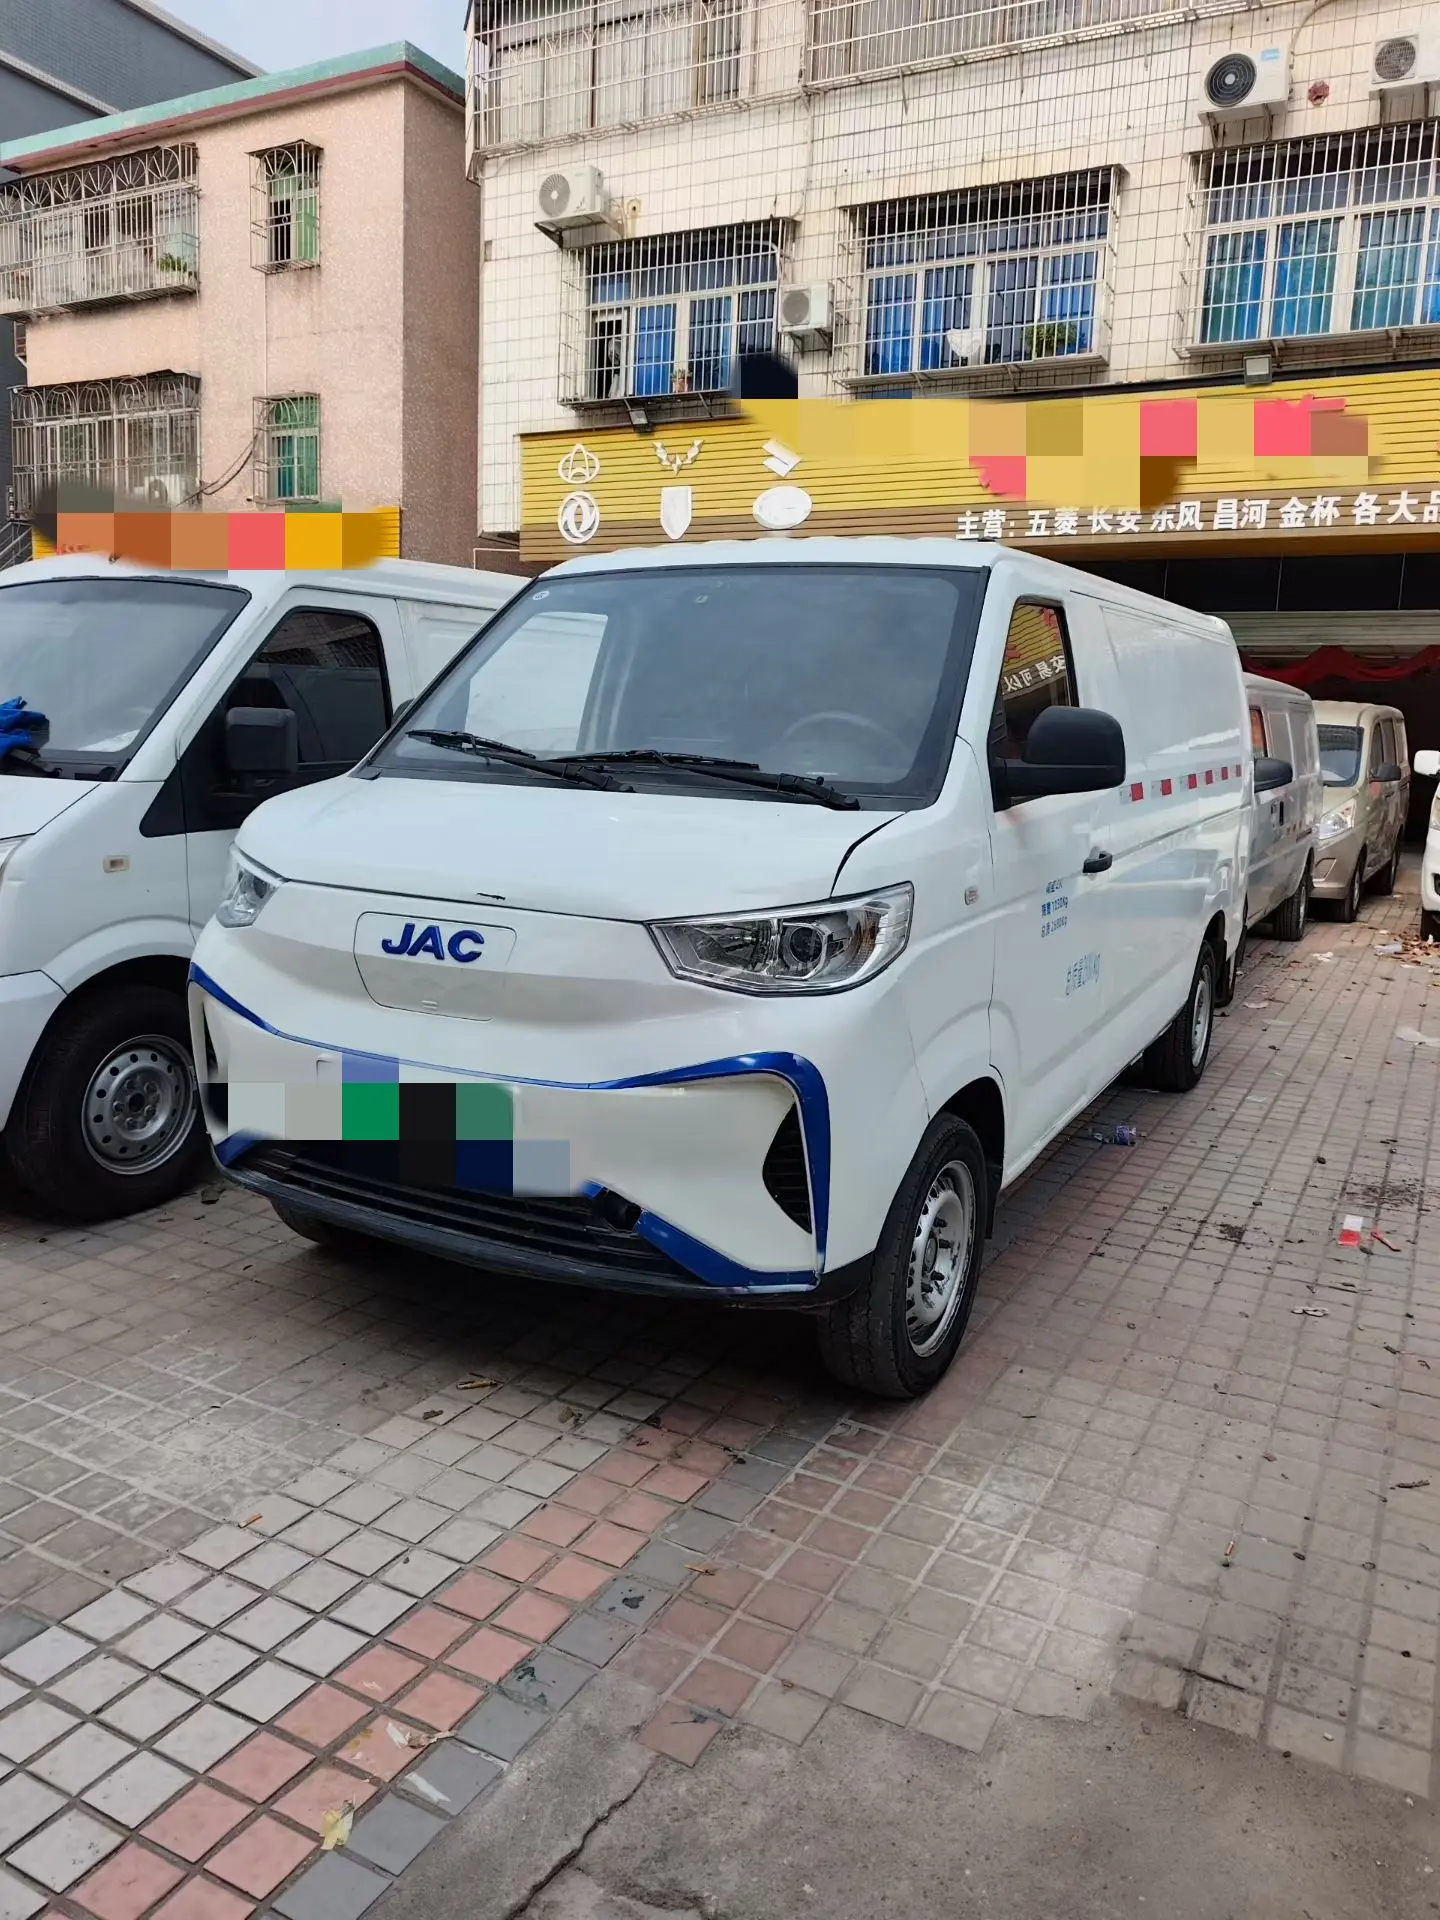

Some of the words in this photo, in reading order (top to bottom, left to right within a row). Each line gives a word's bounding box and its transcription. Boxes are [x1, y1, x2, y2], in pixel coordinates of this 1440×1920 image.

[1025, 506, 1080, 537] 五菱
[1088, 505, 1142, 534] 长安
[1212, 498, 1270, 530] 昌河
[1279, 495, 1342, 529] 金杯
[381, 922, 485, 963] JAC
